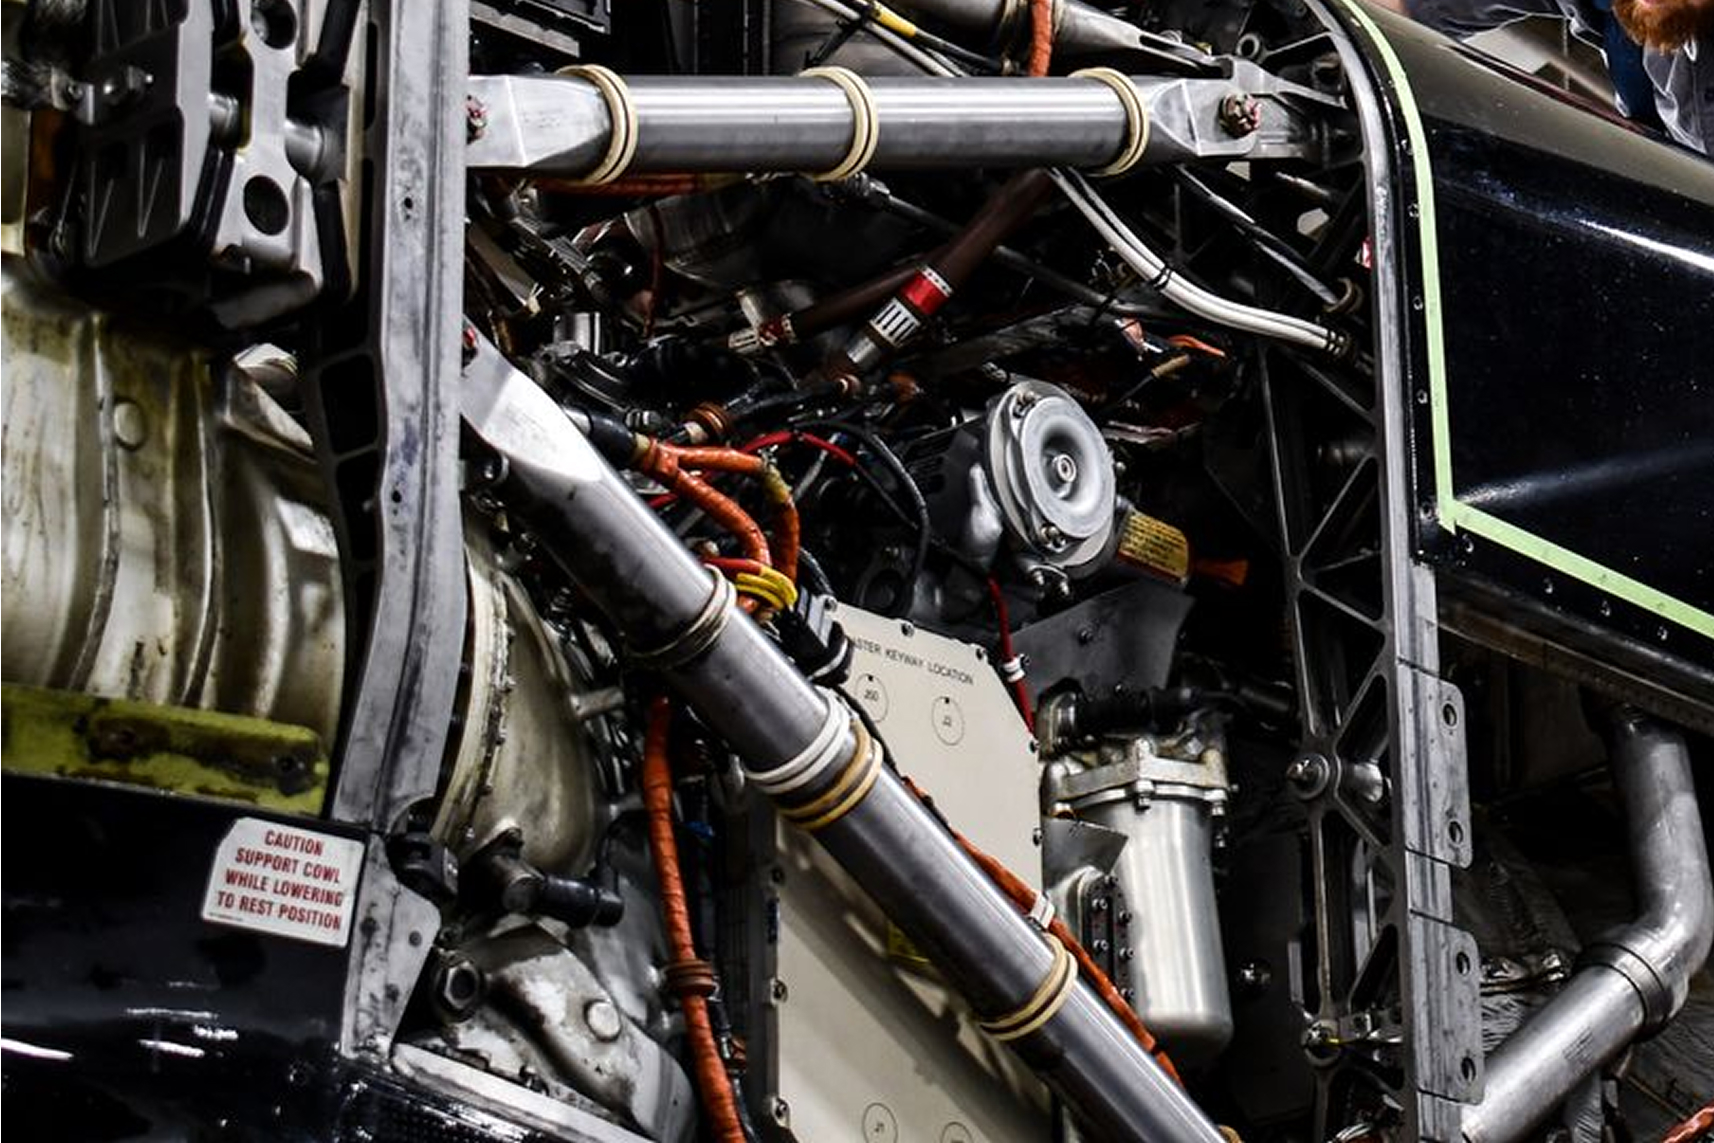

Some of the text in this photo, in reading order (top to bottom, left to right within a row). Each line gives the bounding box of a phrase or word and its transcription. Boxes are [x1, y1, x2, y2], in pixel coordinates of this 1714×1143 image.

[927, 661, 974, 685] LOCATION
[264, 829, 323, 856] CAUTION
[235, 847, 340, 884] SUPPORT COWL
[225, 868, 344, 908] WHILE LOWERING
[217, 891, 235, 909] TO
[239, 894, 274, 917] REST
[278, 903, 341, 931] POSITION
